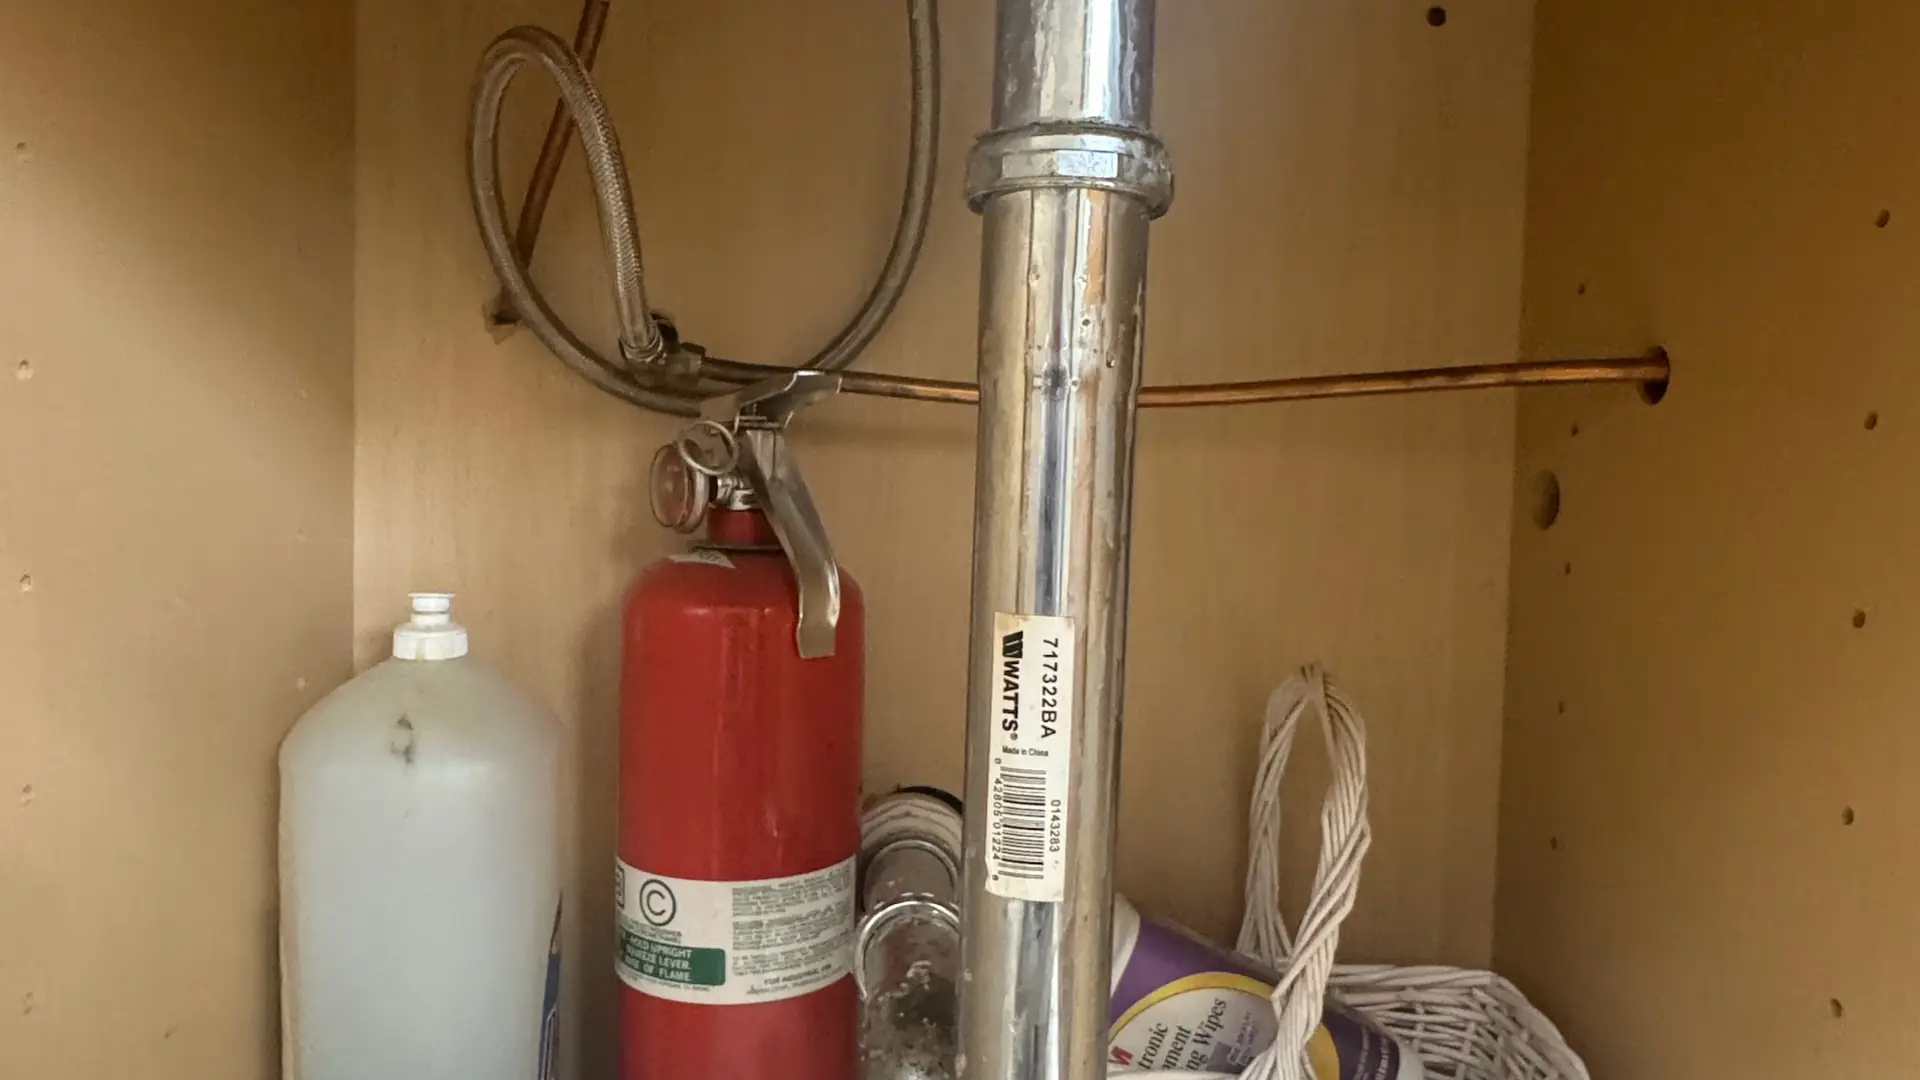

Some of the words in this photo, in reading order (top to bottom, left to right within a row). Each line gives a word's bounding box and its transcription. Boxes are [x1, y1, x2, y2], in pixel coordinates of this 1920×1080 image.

[1041, 637, 1059, 738] 717322BA
[1002, 745, 1020, 755] Made
[1028, 748, 1049, 756] China
[1049, 799, 1062, 852] 0143283
[1191, 997, 1227, 1046] Wipes
